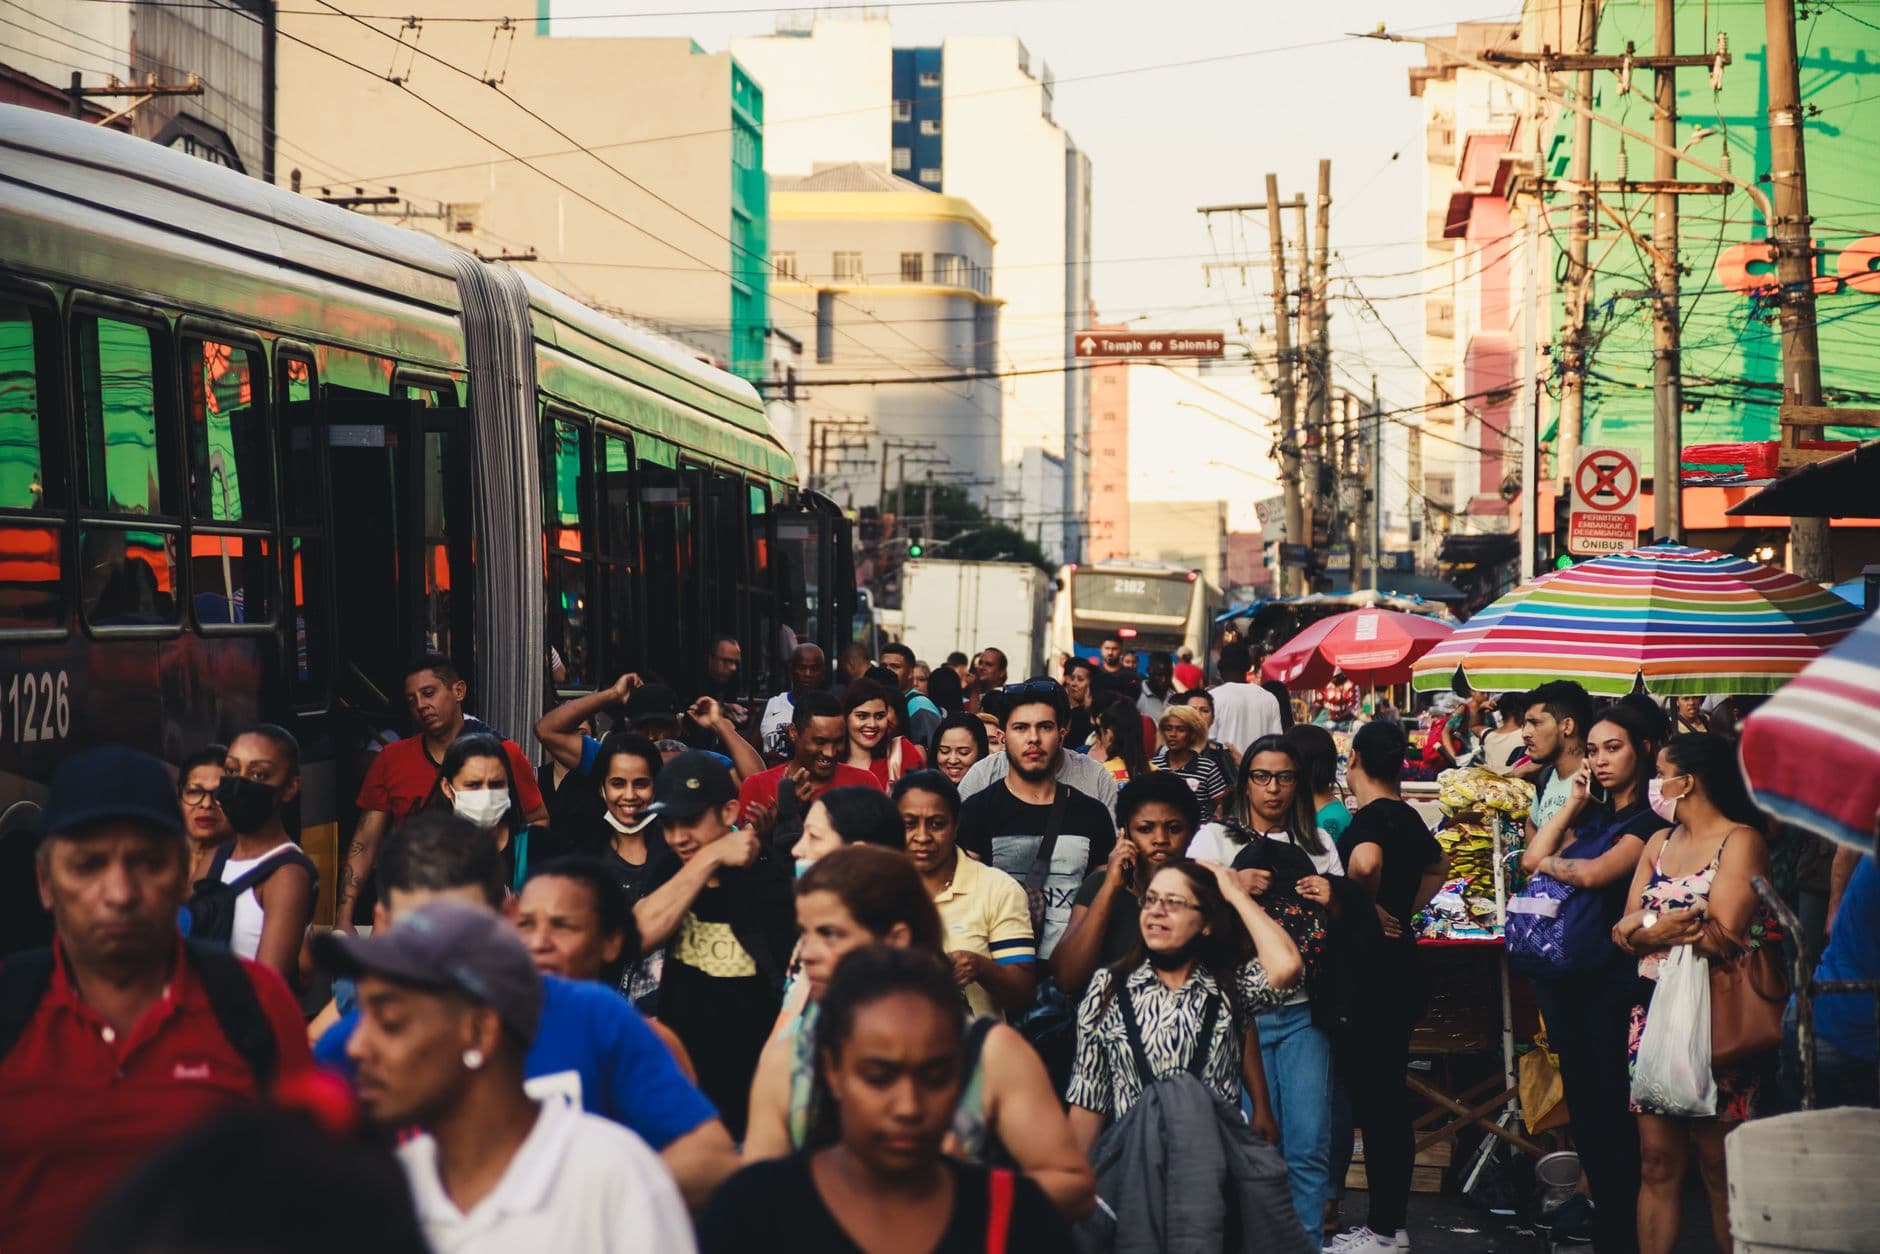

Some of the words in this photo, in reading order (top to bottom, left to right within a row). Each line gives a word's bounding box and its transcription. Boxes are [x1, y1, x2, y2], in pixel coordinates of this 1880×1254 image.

[1101, 339, 1143, 352] Templo
[1169, 338, 1220, 351] Salomão
[1578, 521, 1622, 529] EMBARQUE
[1574, 529, 1632, 537] DESEMBARQUE
